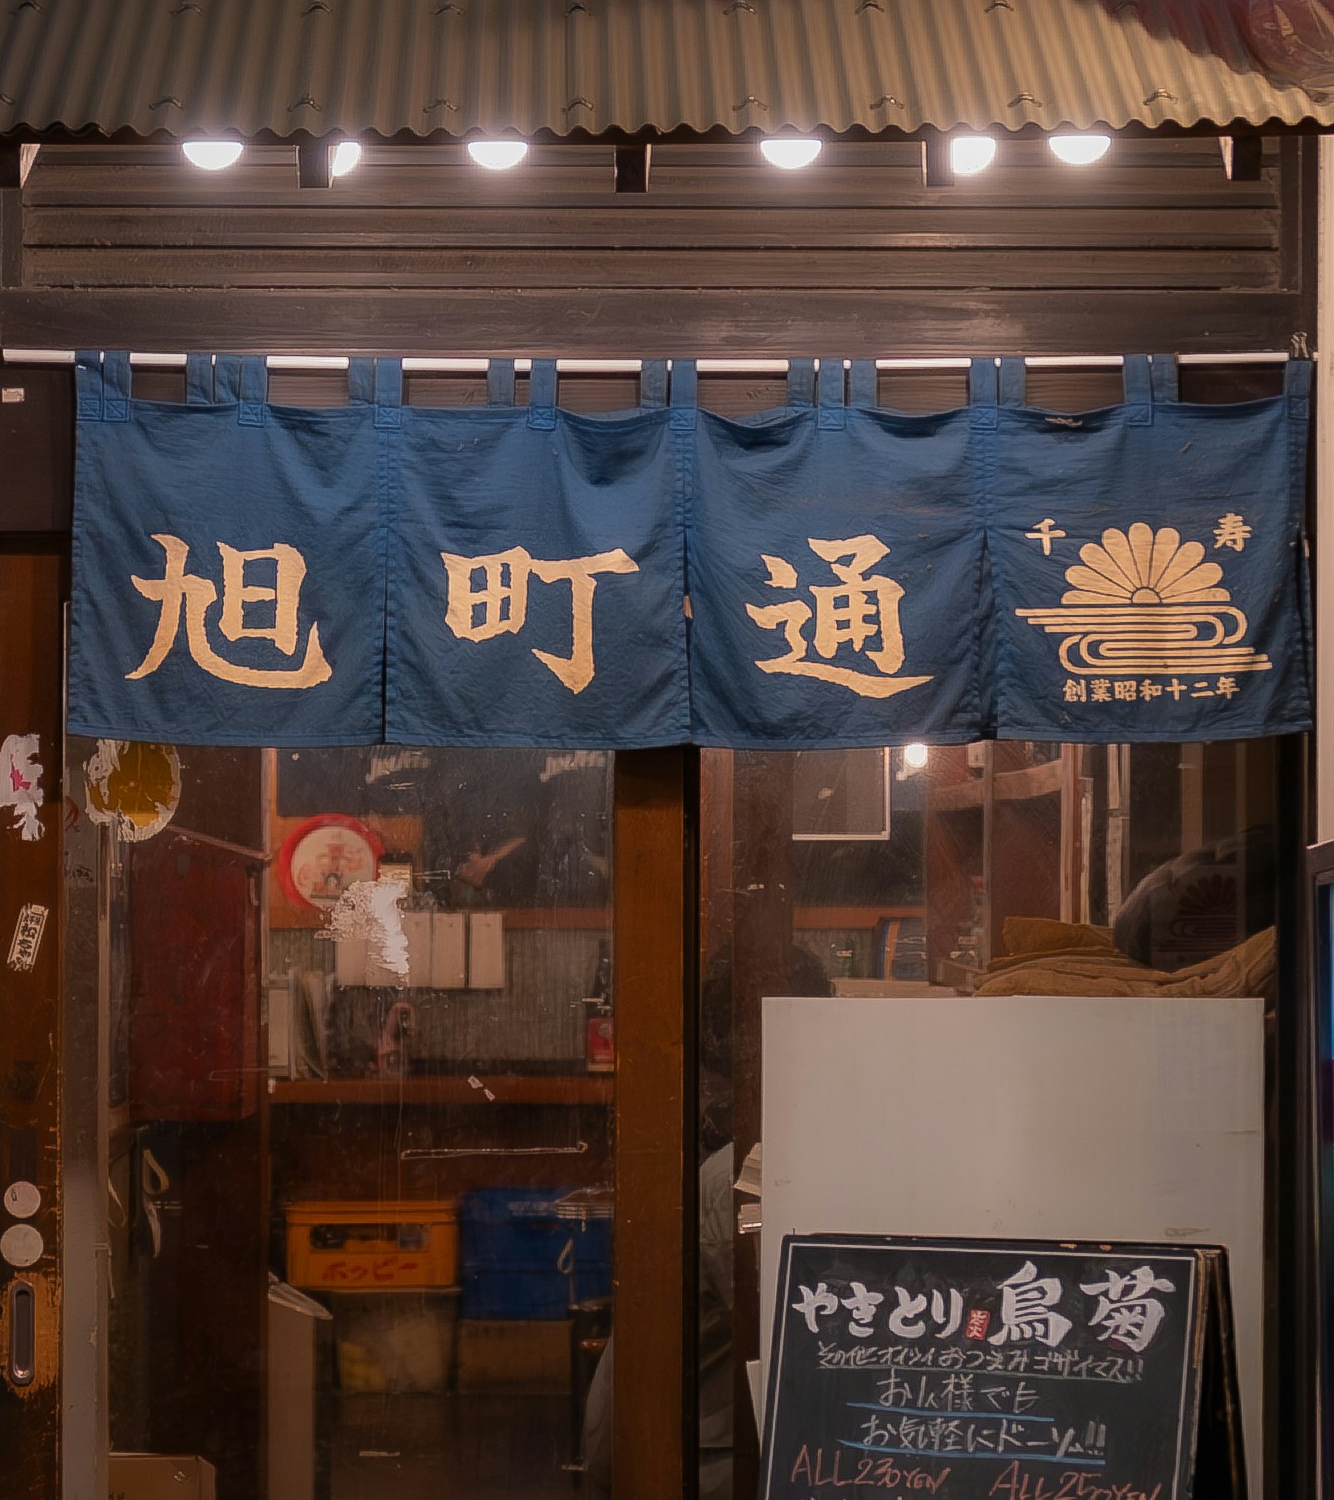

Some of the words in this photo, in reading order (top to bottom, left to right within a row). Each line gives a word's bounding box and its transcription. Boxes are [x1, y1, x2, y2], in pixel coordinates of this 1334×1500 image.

[1025, 516, 1065, 558] 千
[1213, 509, 1251, 552] 寿
[1062, 676, 1241, 704] 創業昭和十二年
[791, 1279, 964, 1341] やきとり
[986, 1258, 1178, 1354] 鳥菊
